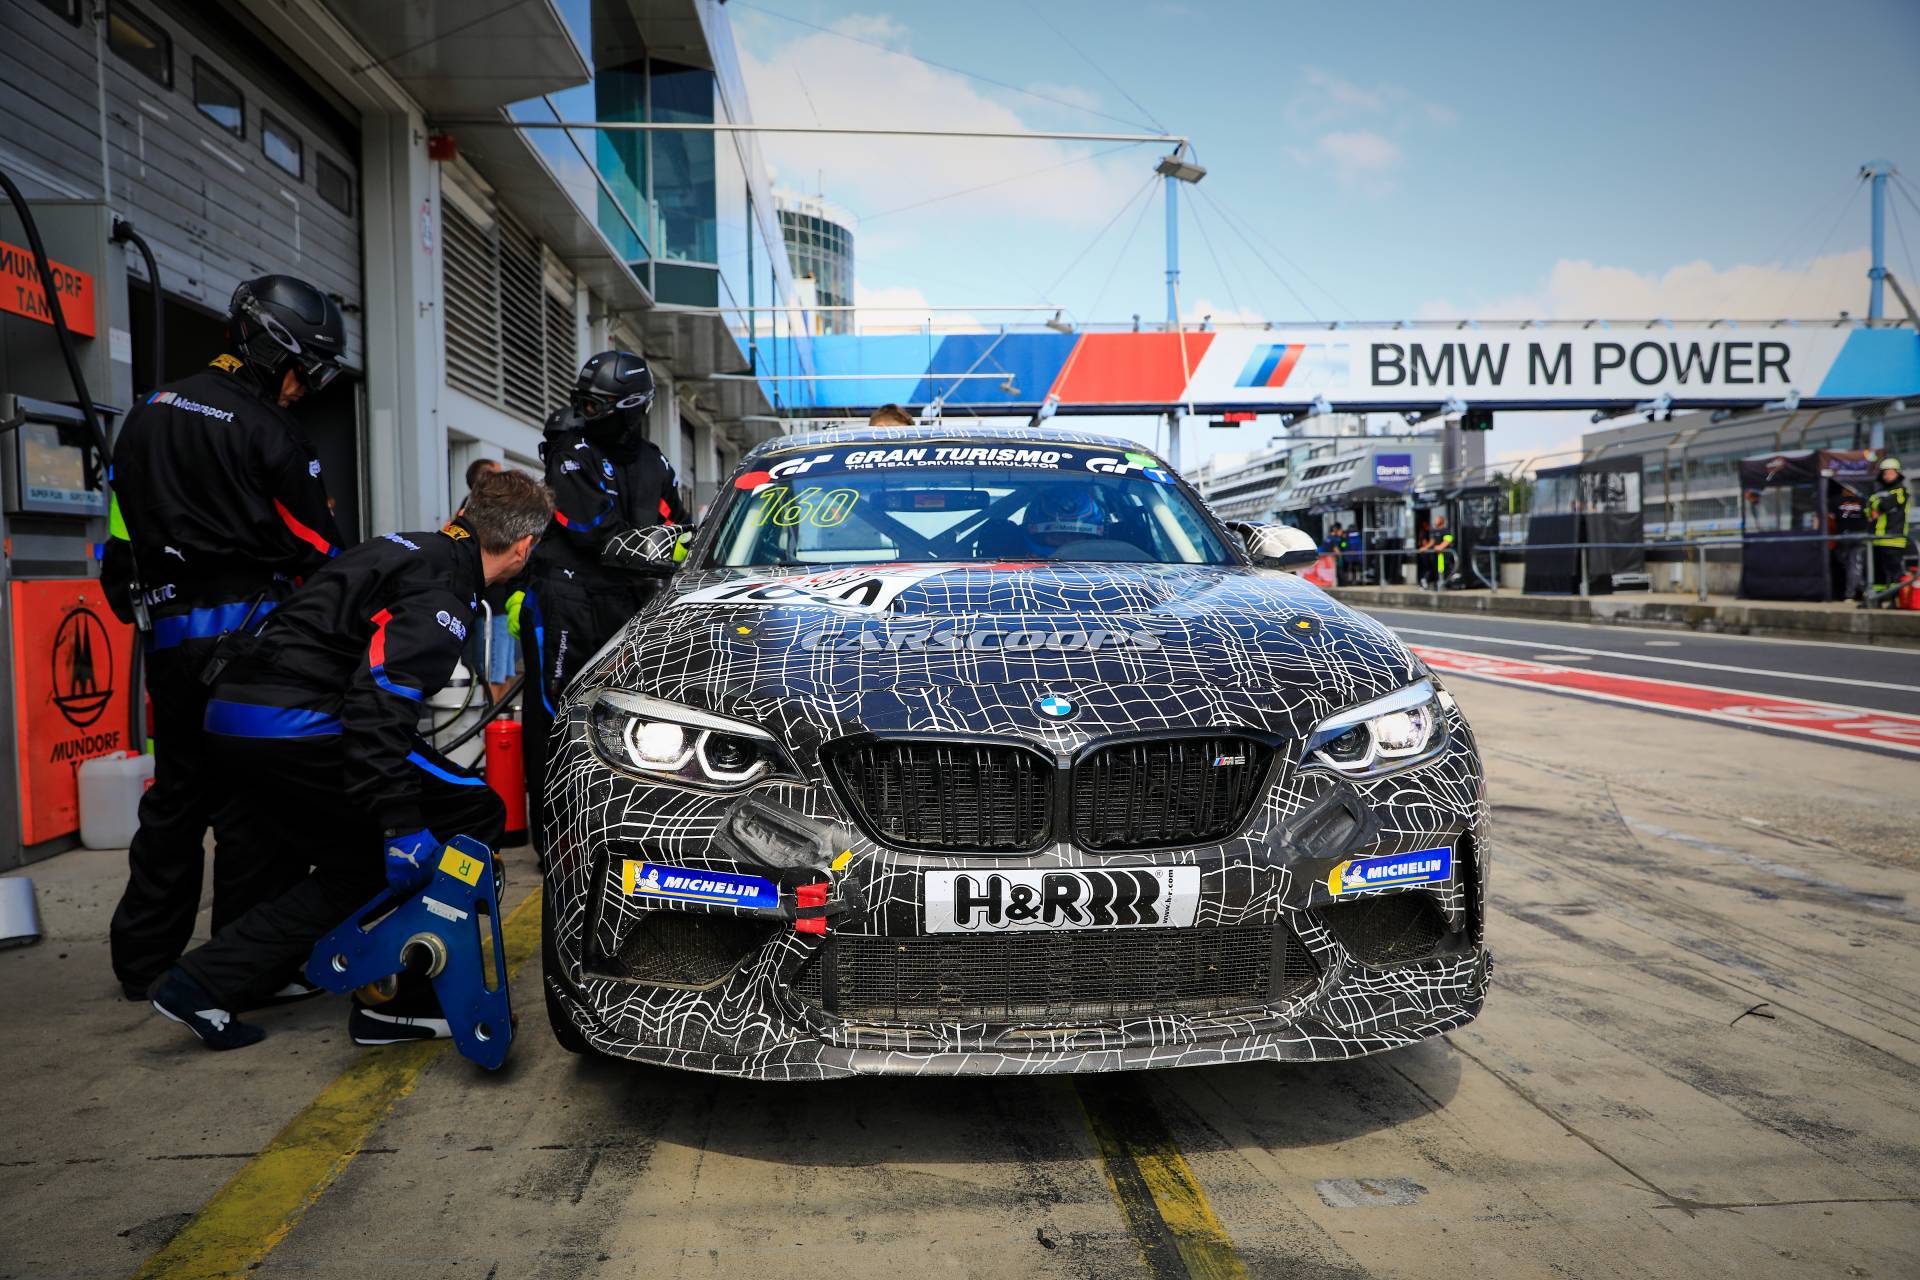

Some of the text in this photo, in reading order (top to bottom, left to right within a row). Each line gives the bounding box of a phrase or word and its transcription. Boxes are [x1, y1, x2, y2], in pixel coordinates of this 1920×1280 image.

[0, 247, 82, 299] MUNORF
[16, 285, 51, 319] TAN
[1371, 341, 1791, 386] BMW M POWER
[173, 397, 234, 422] Motorsport
[844, 448, 928, 466] GRAN
[978, 459, 1059, 470] SIMULATOR
[1149, 468, 1167, 482] T
[756, 487, 860, 528] 160
[554, 630, 569, 678] Motorsport
[50, 731, 120, 763] MUNDORF
[459, 860, 472, 877] R
[1367, 860, 1442, 880] MICHELIN
[663, 876, 760, 897] MICHELIN
